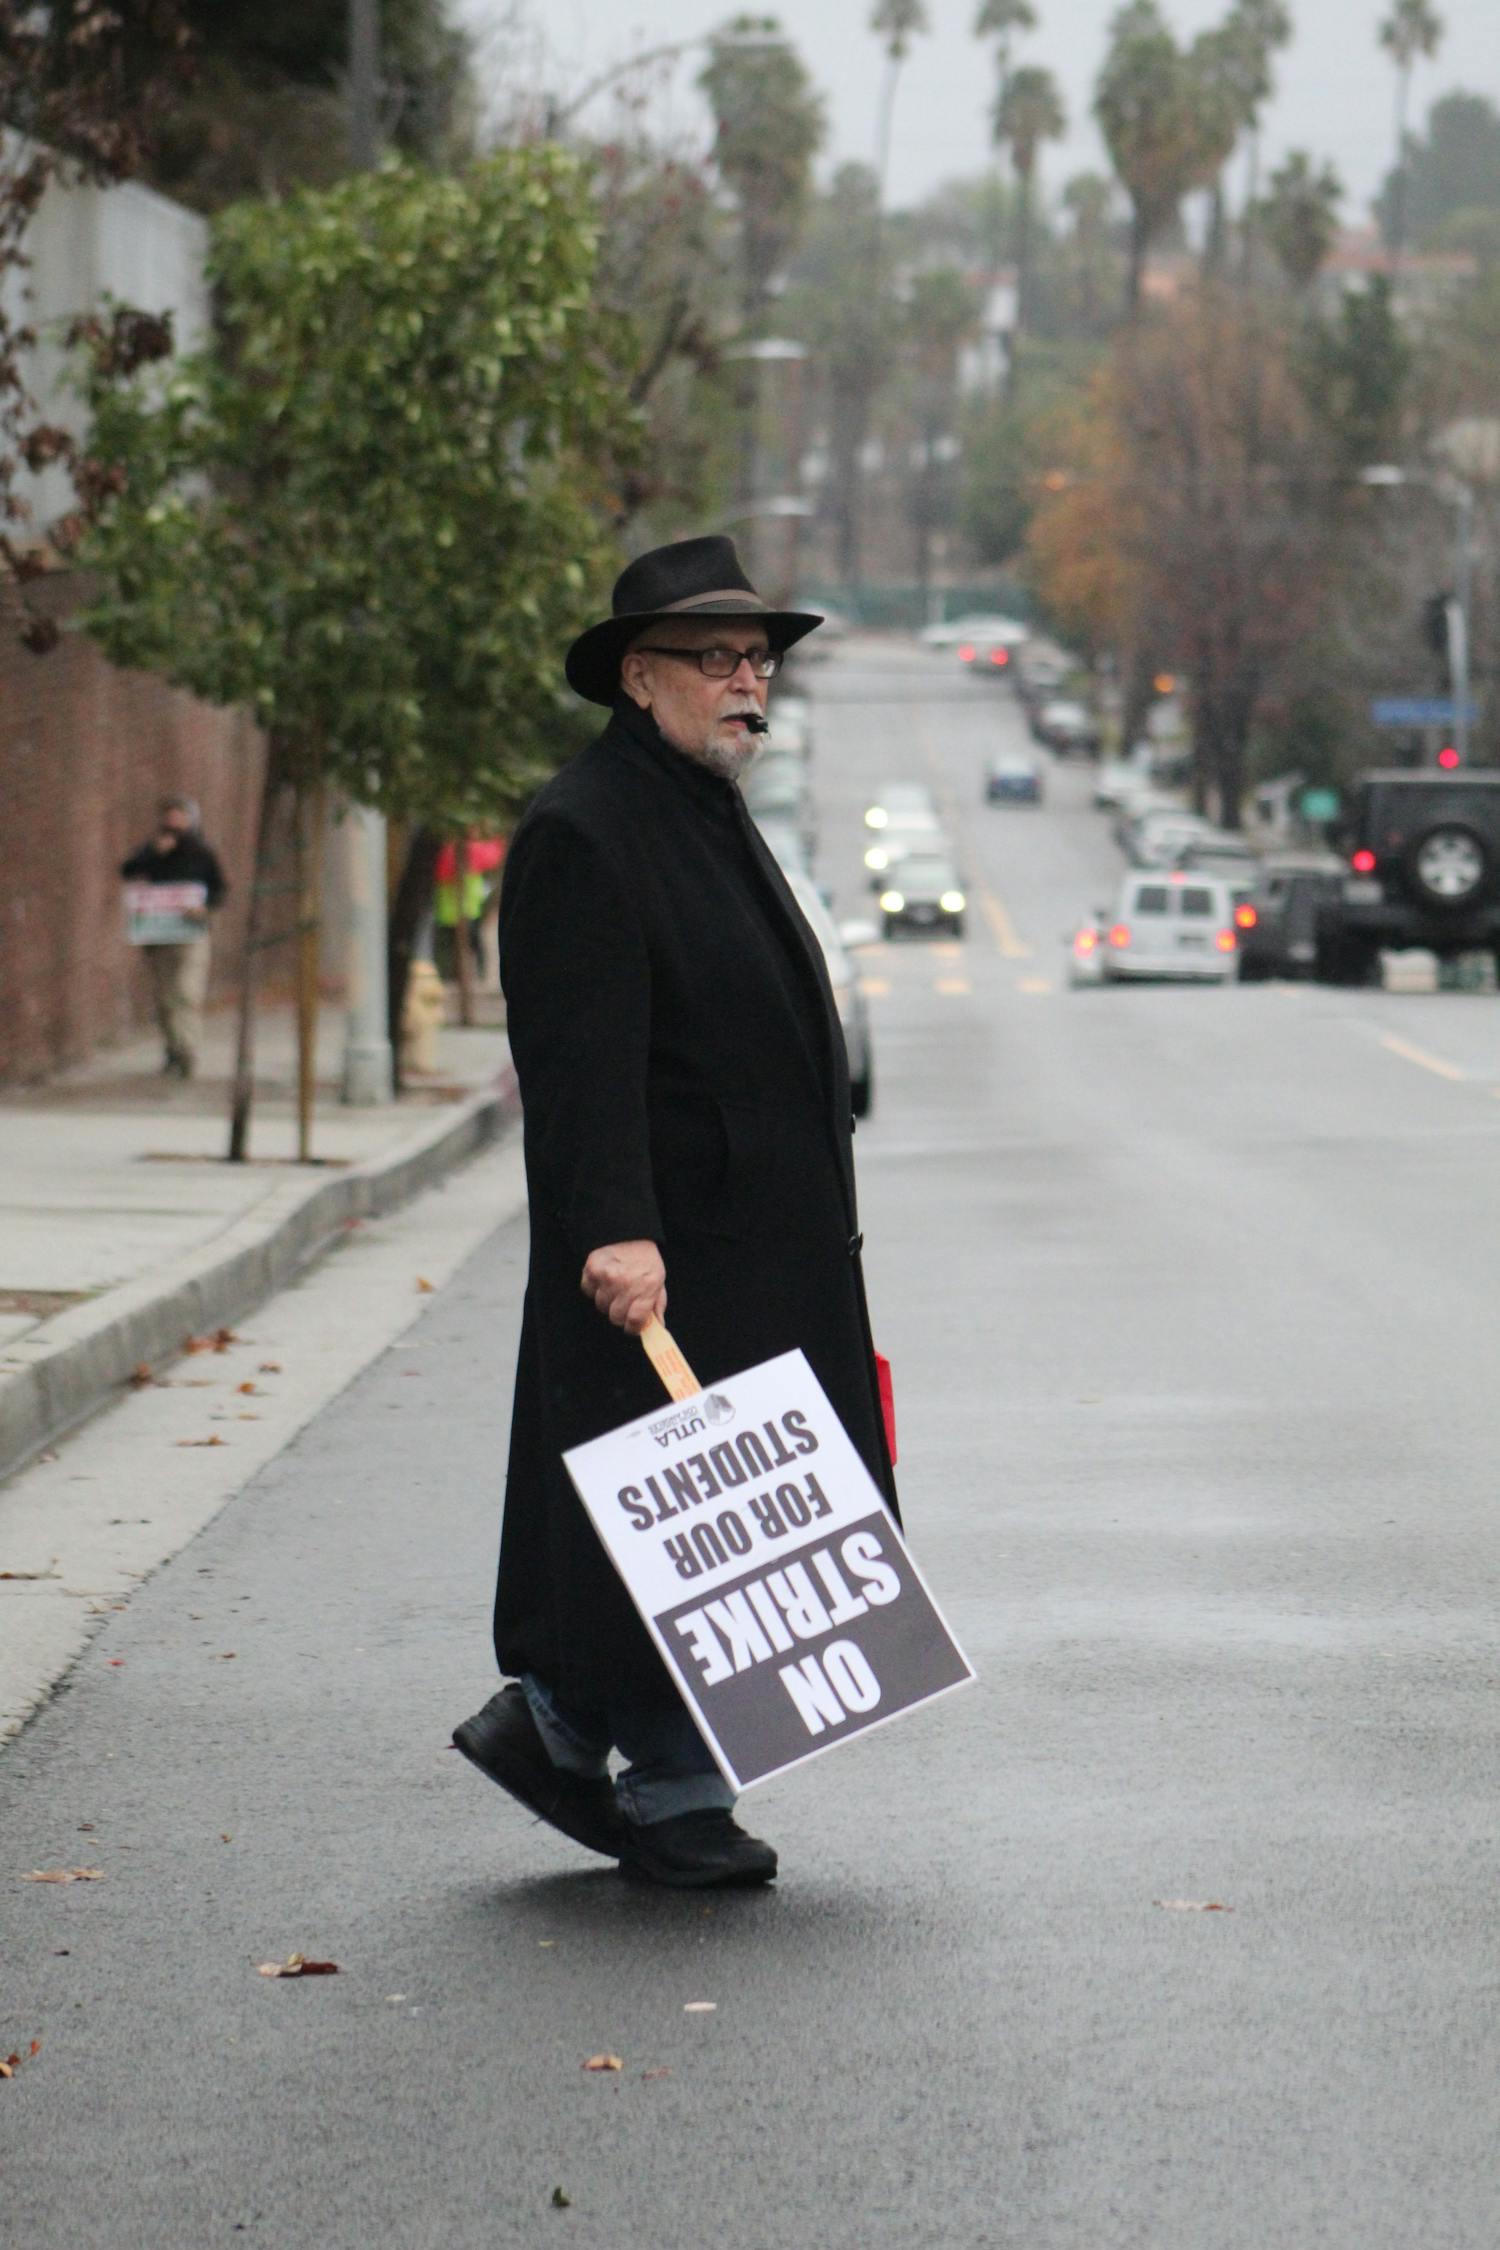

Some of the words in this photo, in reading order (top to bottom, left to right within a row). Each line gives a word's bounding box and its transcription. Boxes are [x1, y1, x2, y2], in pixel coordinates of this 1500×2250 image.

[617, 1409, 819, 1531] STUDENTS
[654, 1417, 706, 1447] UTLA
[662, 1510, 753, 1580] OUR
[748, 1472, 833, 1541] FOR
[673, 1531, 901, 1686] STRIKE
[778, 1639, 881, 1736] ON
